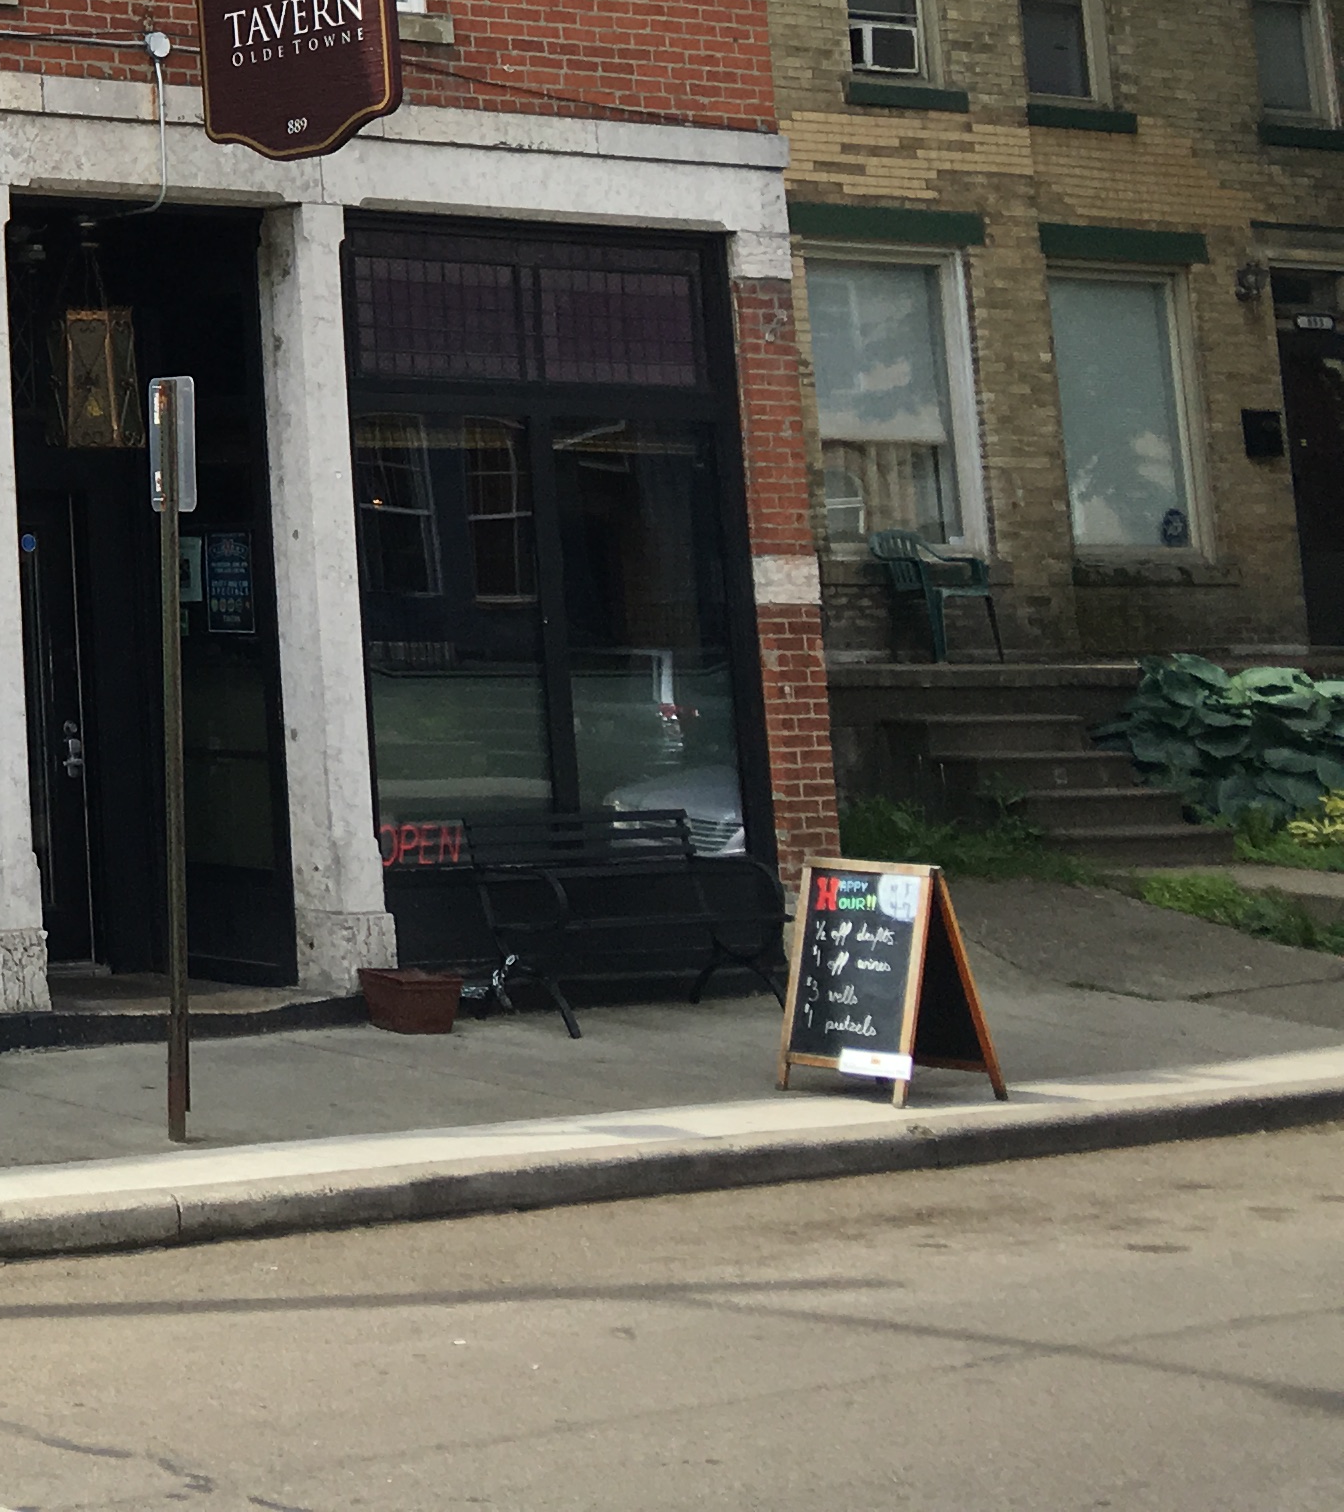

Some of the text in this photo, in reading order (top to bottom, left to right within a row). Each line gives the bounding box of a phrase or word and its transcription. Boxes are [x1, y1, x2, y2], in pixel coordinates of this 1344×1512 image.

[232, 27, 365, 67] OLDE TOWNE
[287, 117, 308, 135] 889
[380, 824, 463, 867] OPEN
[830, 919, 853, 947] off
[827, 950, 850, 976] off
[857, 958, 892, 972] wines
[825, 1015, 877, 1037] pretzels
